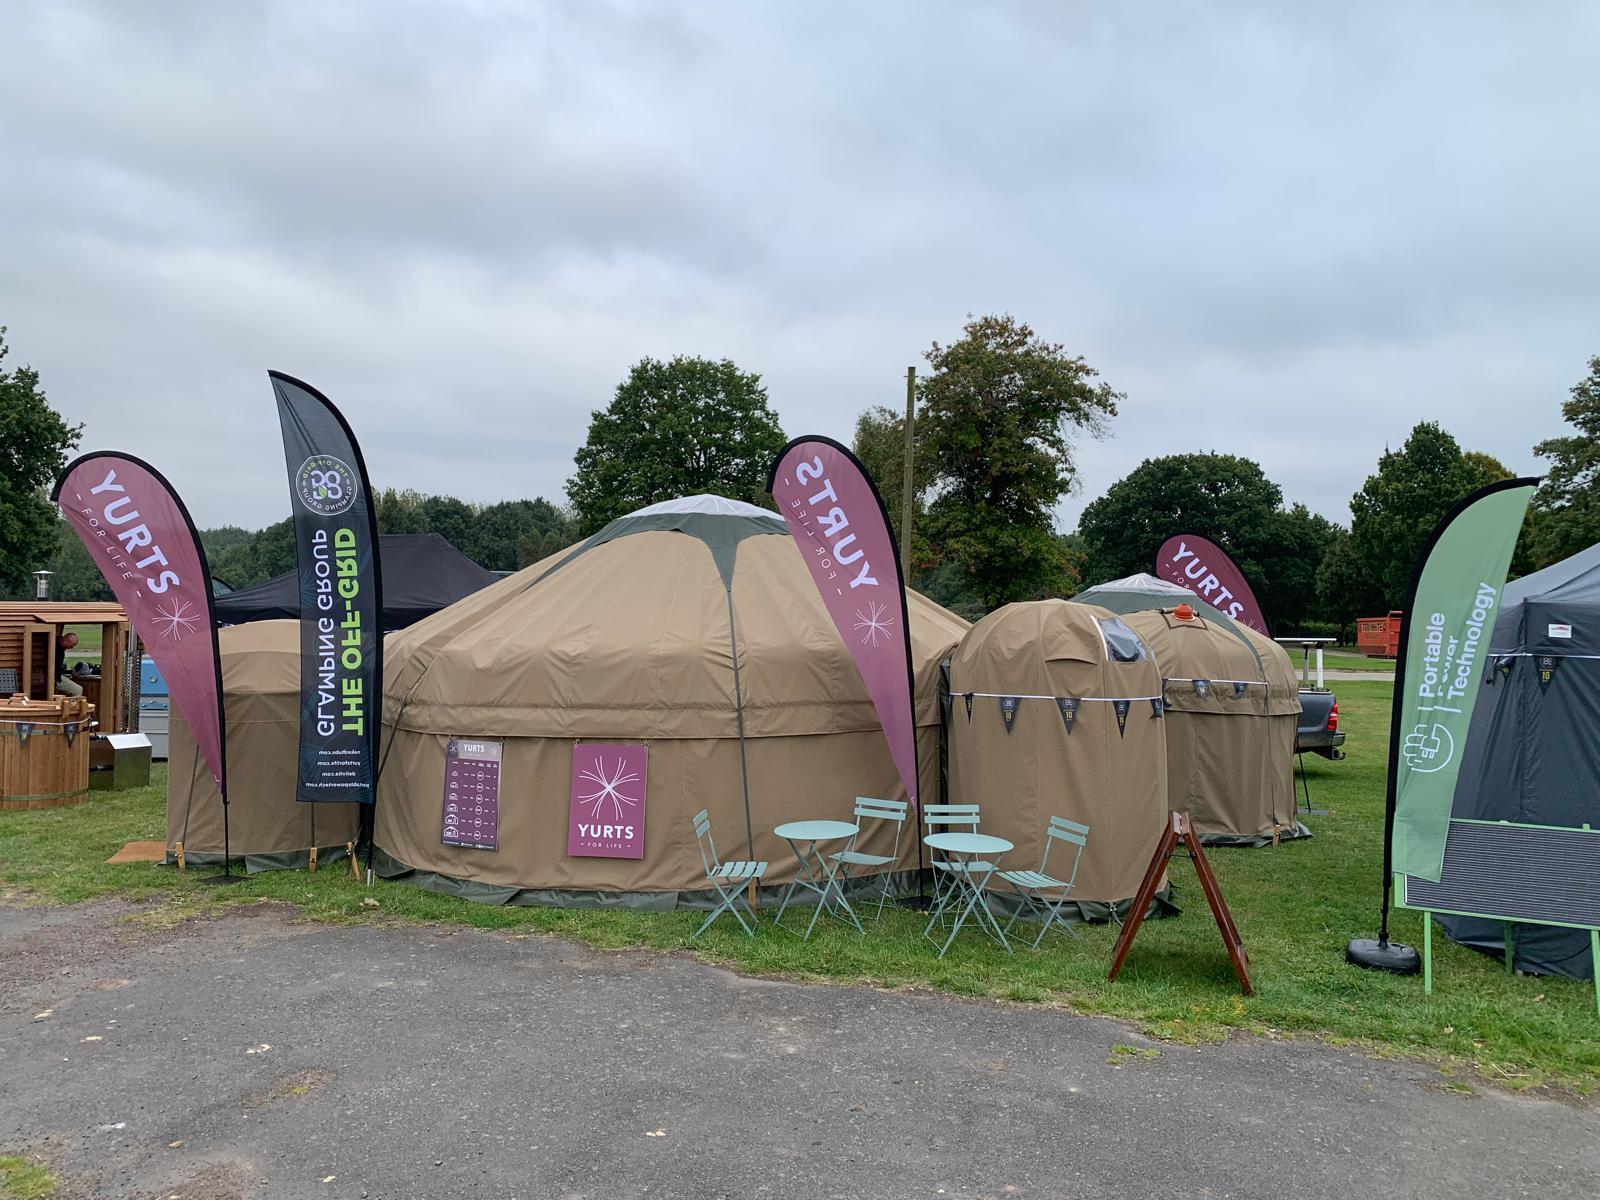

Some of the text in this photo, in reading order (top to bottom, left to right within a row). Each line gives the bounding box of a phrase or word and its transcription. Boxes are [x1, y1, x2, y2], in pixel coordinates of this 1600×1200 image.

[81, 508, 133, 580] FOR LIFE
[90, 469, 180, 594] YURTS
[1172, 541, 1244, 619] YURTS
[1172, 571, 1190, 590] FOR
[1419, 612, 1446, 698] Portable
[1446, 582, 1497, 700] Technology
[1542, 672, 1550, 680] 10
[1066, 711, 1073, 719] 10
[463, 744, 485, 753] YURTS
[578, 824, 634, 840] YURTS
